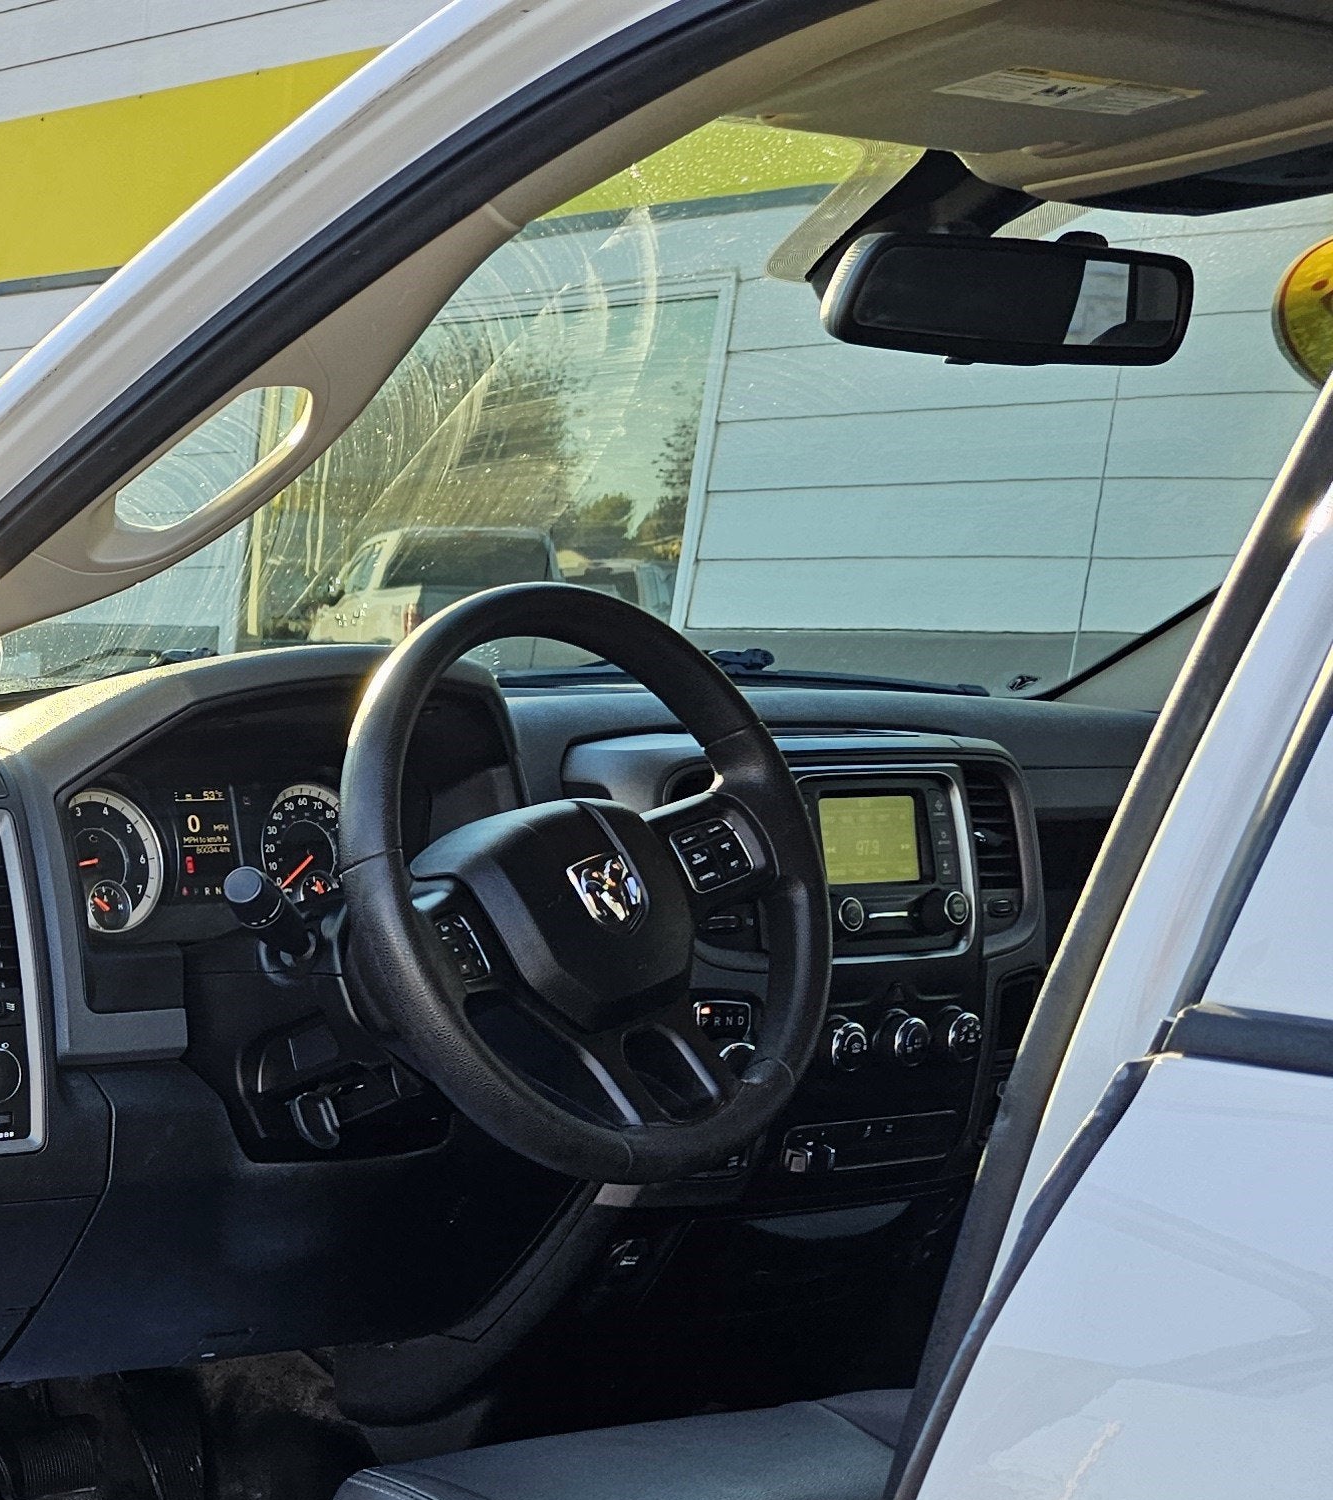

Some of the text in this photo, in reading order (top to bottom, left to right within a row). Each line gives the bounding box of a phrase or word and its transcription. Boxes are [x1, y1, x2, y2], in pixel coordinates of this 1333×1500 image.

[297, 797, 308, 806] 60
[313, 801, 323, 810] 70
[284, 802, 294, 811] 50
[273, 812, 283, 821] 40
[325, 810, 336, 819] 80
[266, 826, 277, 835] 30
[264, 844, 275, 853] 20
[268, 862, 278, 871] 10
